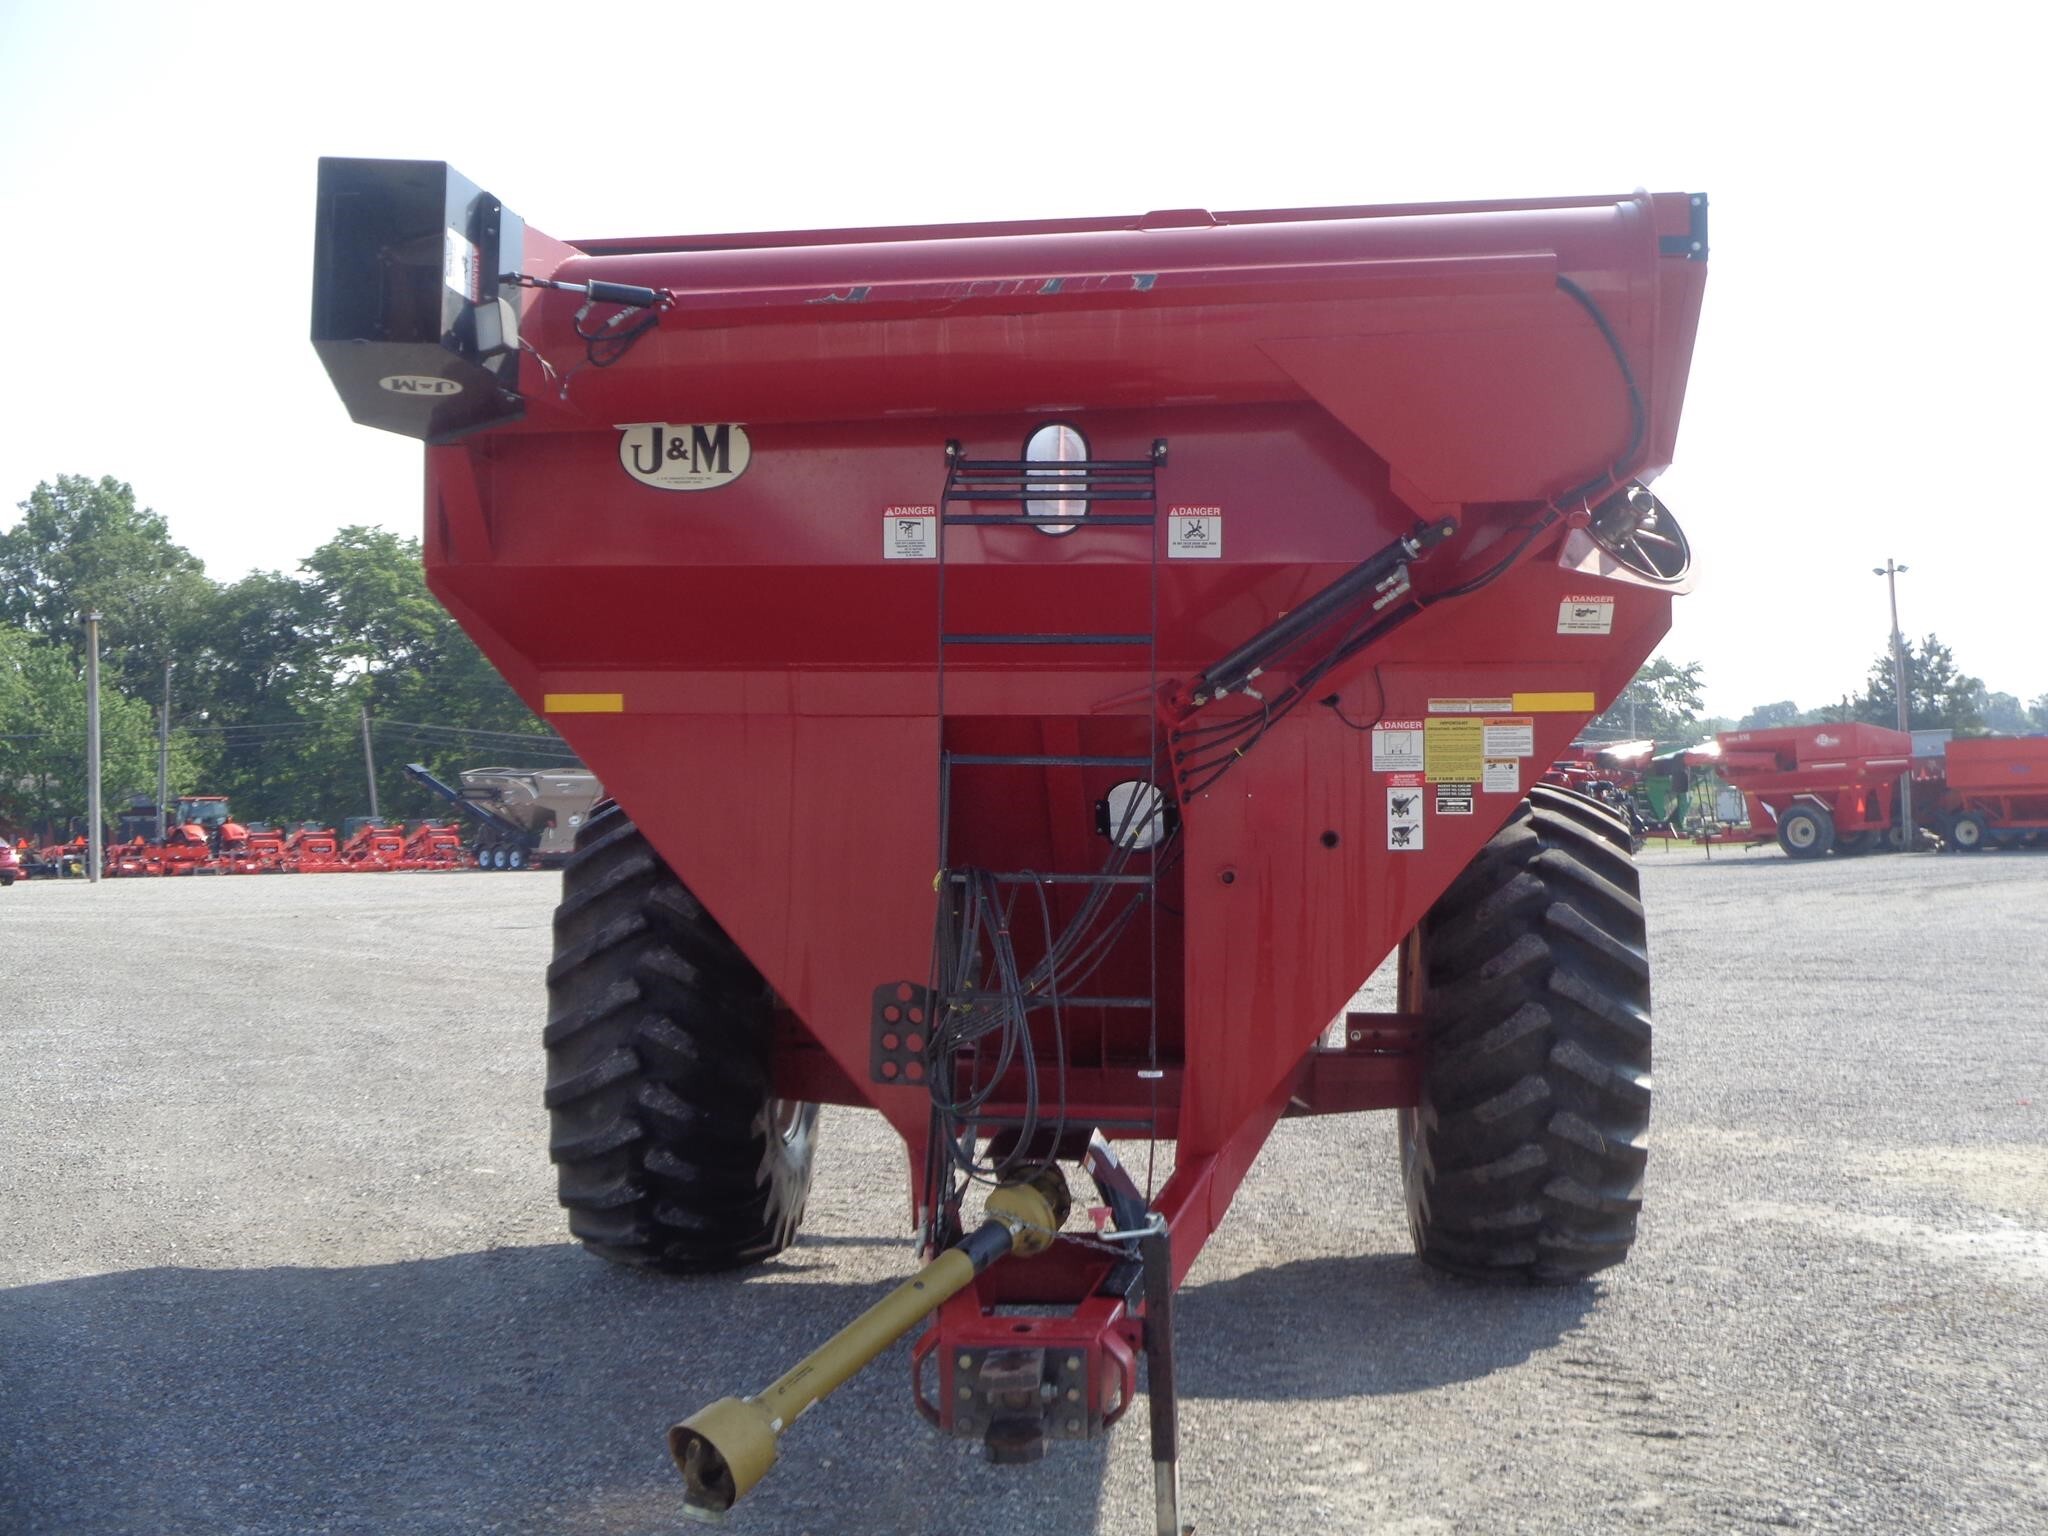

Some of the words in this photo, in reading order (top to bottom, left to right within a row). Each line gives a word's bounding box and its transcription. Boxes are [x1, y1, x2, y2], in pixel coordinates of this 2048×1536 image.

[630, 424, 732, 475] J&M
[894, 506, 935, 515] DANGER
[1178, 507, 1220, 515] DANGER
[1384, 721, 1423, 729] DANGER
